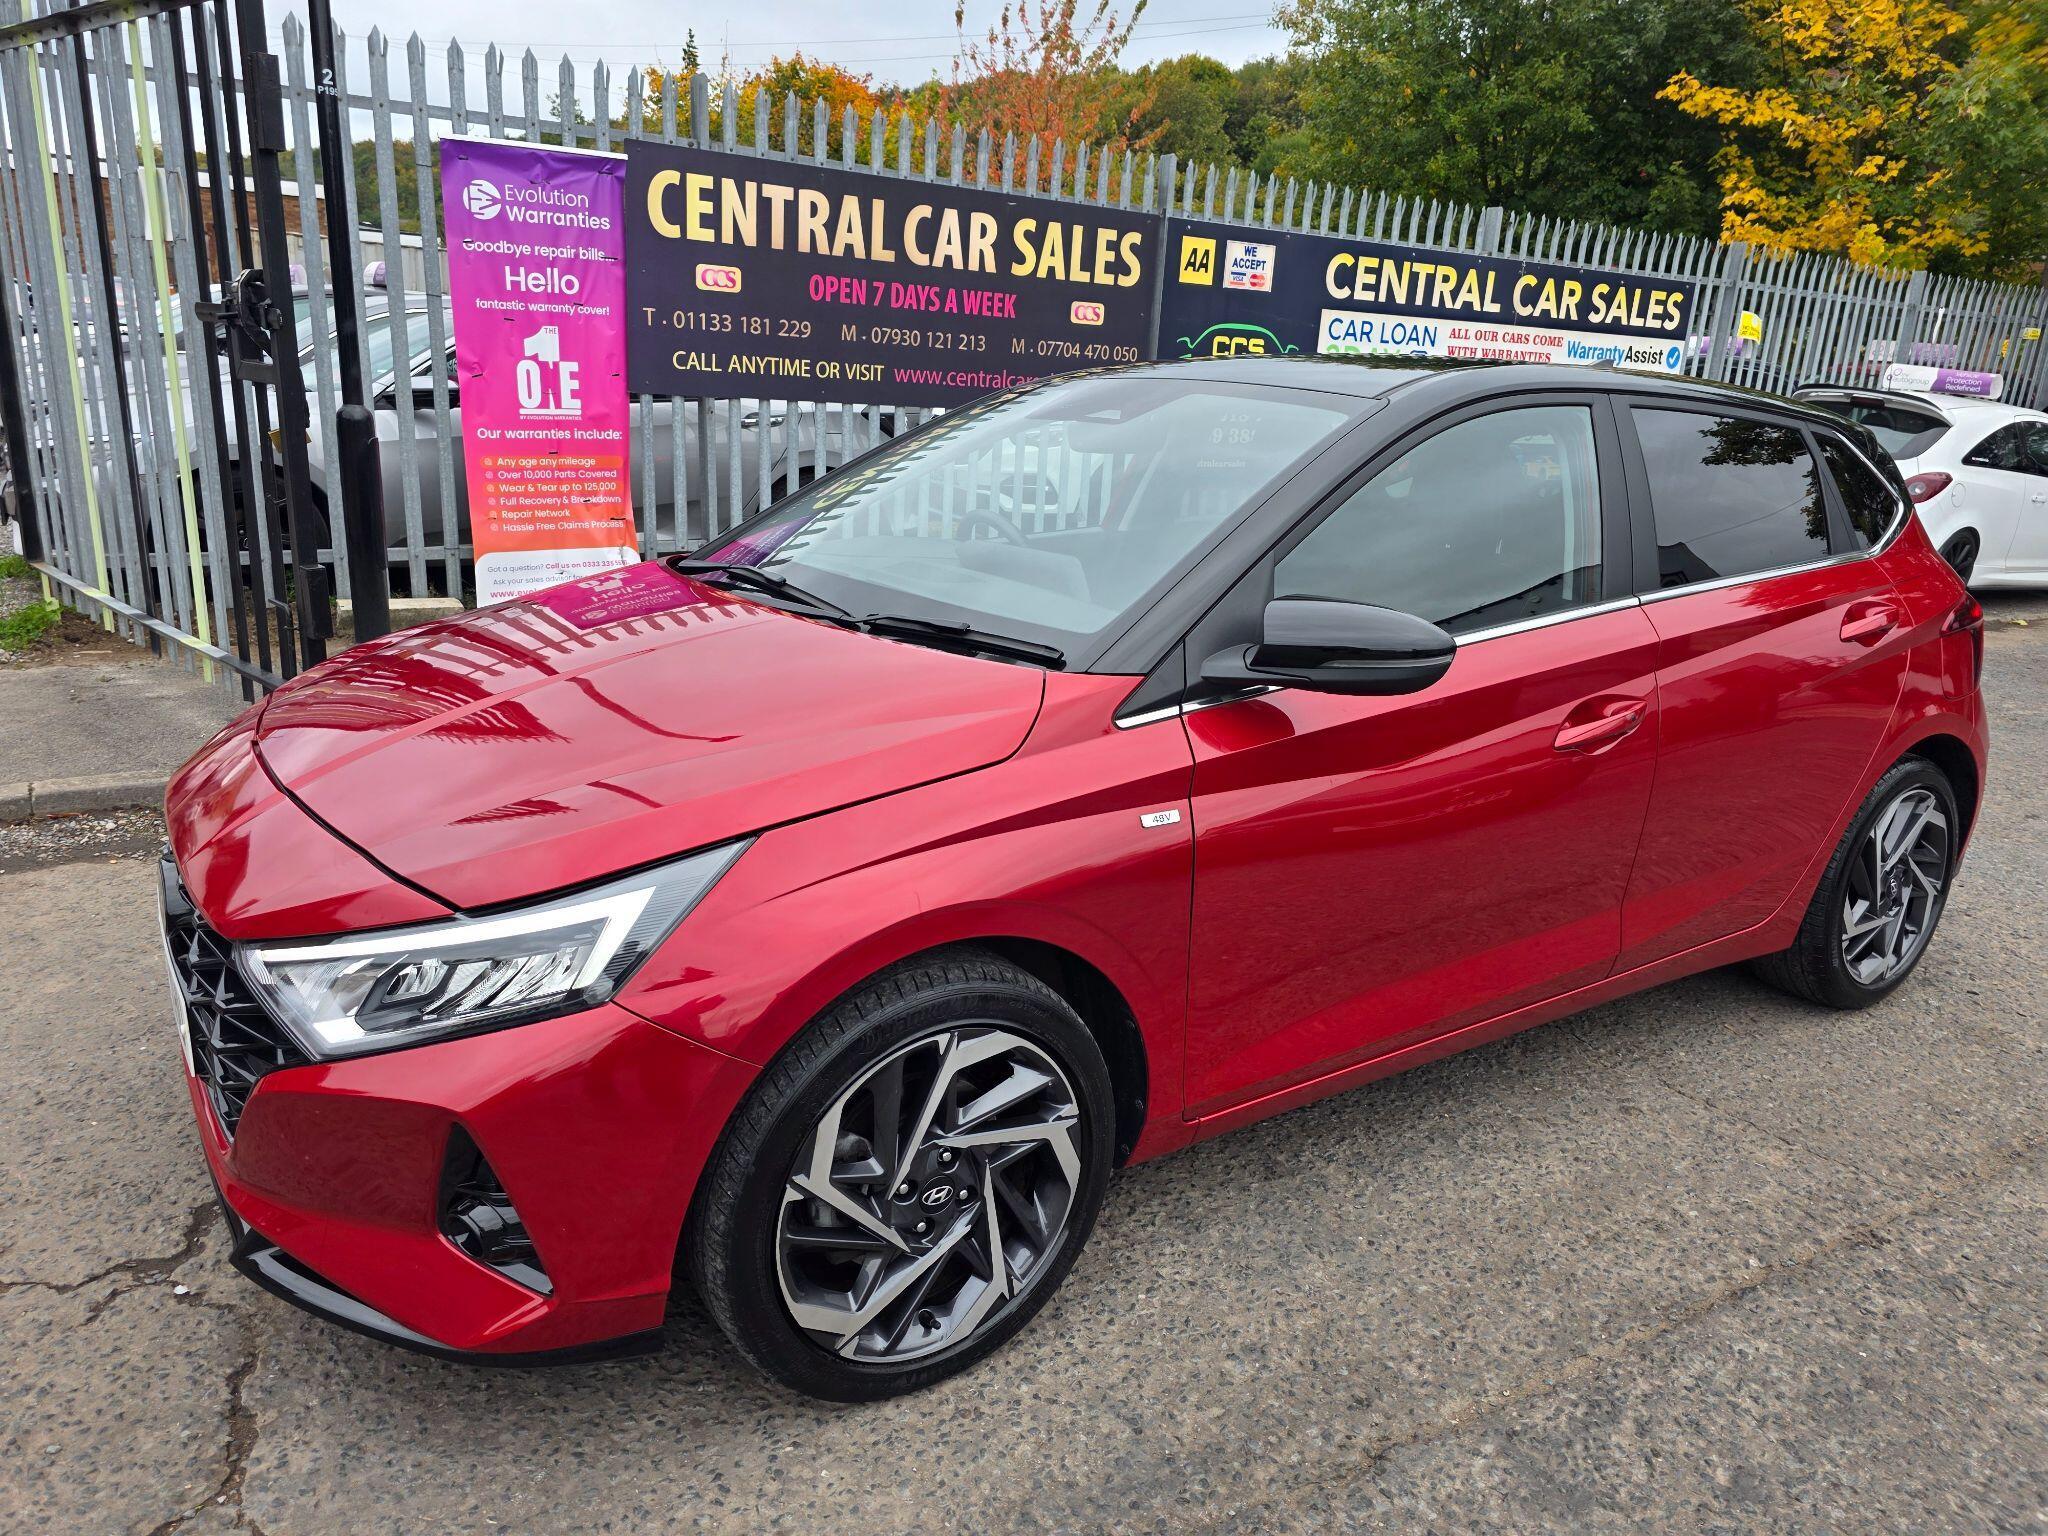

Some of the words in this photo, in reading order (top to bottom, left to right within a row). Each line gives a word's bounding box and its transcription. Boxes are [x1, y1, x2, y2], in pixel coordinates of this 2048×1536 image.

[322, 69, 333, 85] 2
[505, 185, 589, 208] Evolution
[505, 205, 611, 230] Warranties
[647, 169, 895, 263] CENTRAL
[903, 204, 998, 274] CAR
[1010, 218, 1142, 287] SALES
[463, 239, 531, 258] Goodbye
[535, 245, 576, 260] repair
[1244, 246, 1257, 257] WE
[1184, 247, 1210, 274] AA
[1232, 258, 1266, 271] ACCEPT
[505, 265, 580, 295] Hello
[809, 274, 867, 305] OPEN
[873, 281, 885, 307] 7
[890, 282, 941, 312] DAYS
[944, 288, 958, 314] A
[963, 289, 1017, 319] WEEK
[1325, 252, 1501, 313] CENTRAL
[1513, 274, 1582, 321] CAR
[1588, 283, 1684, 331] SALES
[475, 298, 525, 311] fantastic
[528, 303, 575, 316] warranty
[577, 305, 610, 316] cover!
[673, 310, 732, 332] 01133
[740, 316, 771, 336] 181
[777, 319, 812, 338] 229
[1328, 317, 1374, 343] CAR
[1380, 322, 1438, 347] LOAN
[871, 327, 921, 347] 07930
[927, 331, 952, 349] 121
[959, 333, 986, 352] 213
[1448, 327, 1470, 341] ALL
[1475, 329, 1498, 343] OUR
[1502, 332, 1530, 346] CARS
[1533, 335, 1564, 348] COME
[1037, 340, 1080, 358] 07704
[1085, 344, 1110, 360] 470
[1113, 346, 1139, 362] 050
[1447, 345, 1478, 357] WITH
[1482, 348, 1552, 362] WARRANTIES
[672, 351, 722, 372] CALL
[728, 354, 811, 377] ANYTIME
[816, 361, 840, 379] OR
[844, 363, 885, 382] VISIT
[893, 367, 1040, 389] www.centralcar
[1946, 377, 1983, 386] Protection
[1946, 383, 1981, 392] Redefined
[477, 428, 501, 439] Our
[505, 428, 571, 439] warranties
[574, 428, 623, 440] include:
[497, 458, 517, 468] Any
[518, 458, 537, 468] age
[539, 458, 557, 467] any
[558, 457, 596, 468] mileage
[498, 470, 521, 479] Over
[523, 470, 552, 480] 10,000
[555, 470, 576, 478] Parts
[578, 469, 617, 478] Covered
[499, 484, 525, 492] Wear
[527, 484, 535, 492] &
[537, 483, 557, 492] Tear
[560, 484, 570, 494] up
[572, 483, 582, 491] to
[584, 482, 616, 491] 125,000
[500, 497, 516, 505] Full
[519, 496, 561, 506] Recovery
[562, 496, 569, 504] &
[571, 494, 621, 504] Breakdown
[502, 509, 533, 520] Repair
[535, 508, 570, 517] Network
[503, 522, 534, 532] Hassle
[536, 522, 555, 530] Free
[558, 521, 590, 530] Claims
[591, 520, 624, 529] Process
[487, 565, 501, 573] Got
[509, 563, 544, 574] question?
[507, 577, 523, 586] your
[525, 576, 543, 584] sales
[545, 574, 571, 582] advisor
[1153, 813, 1171, 823] 48V
